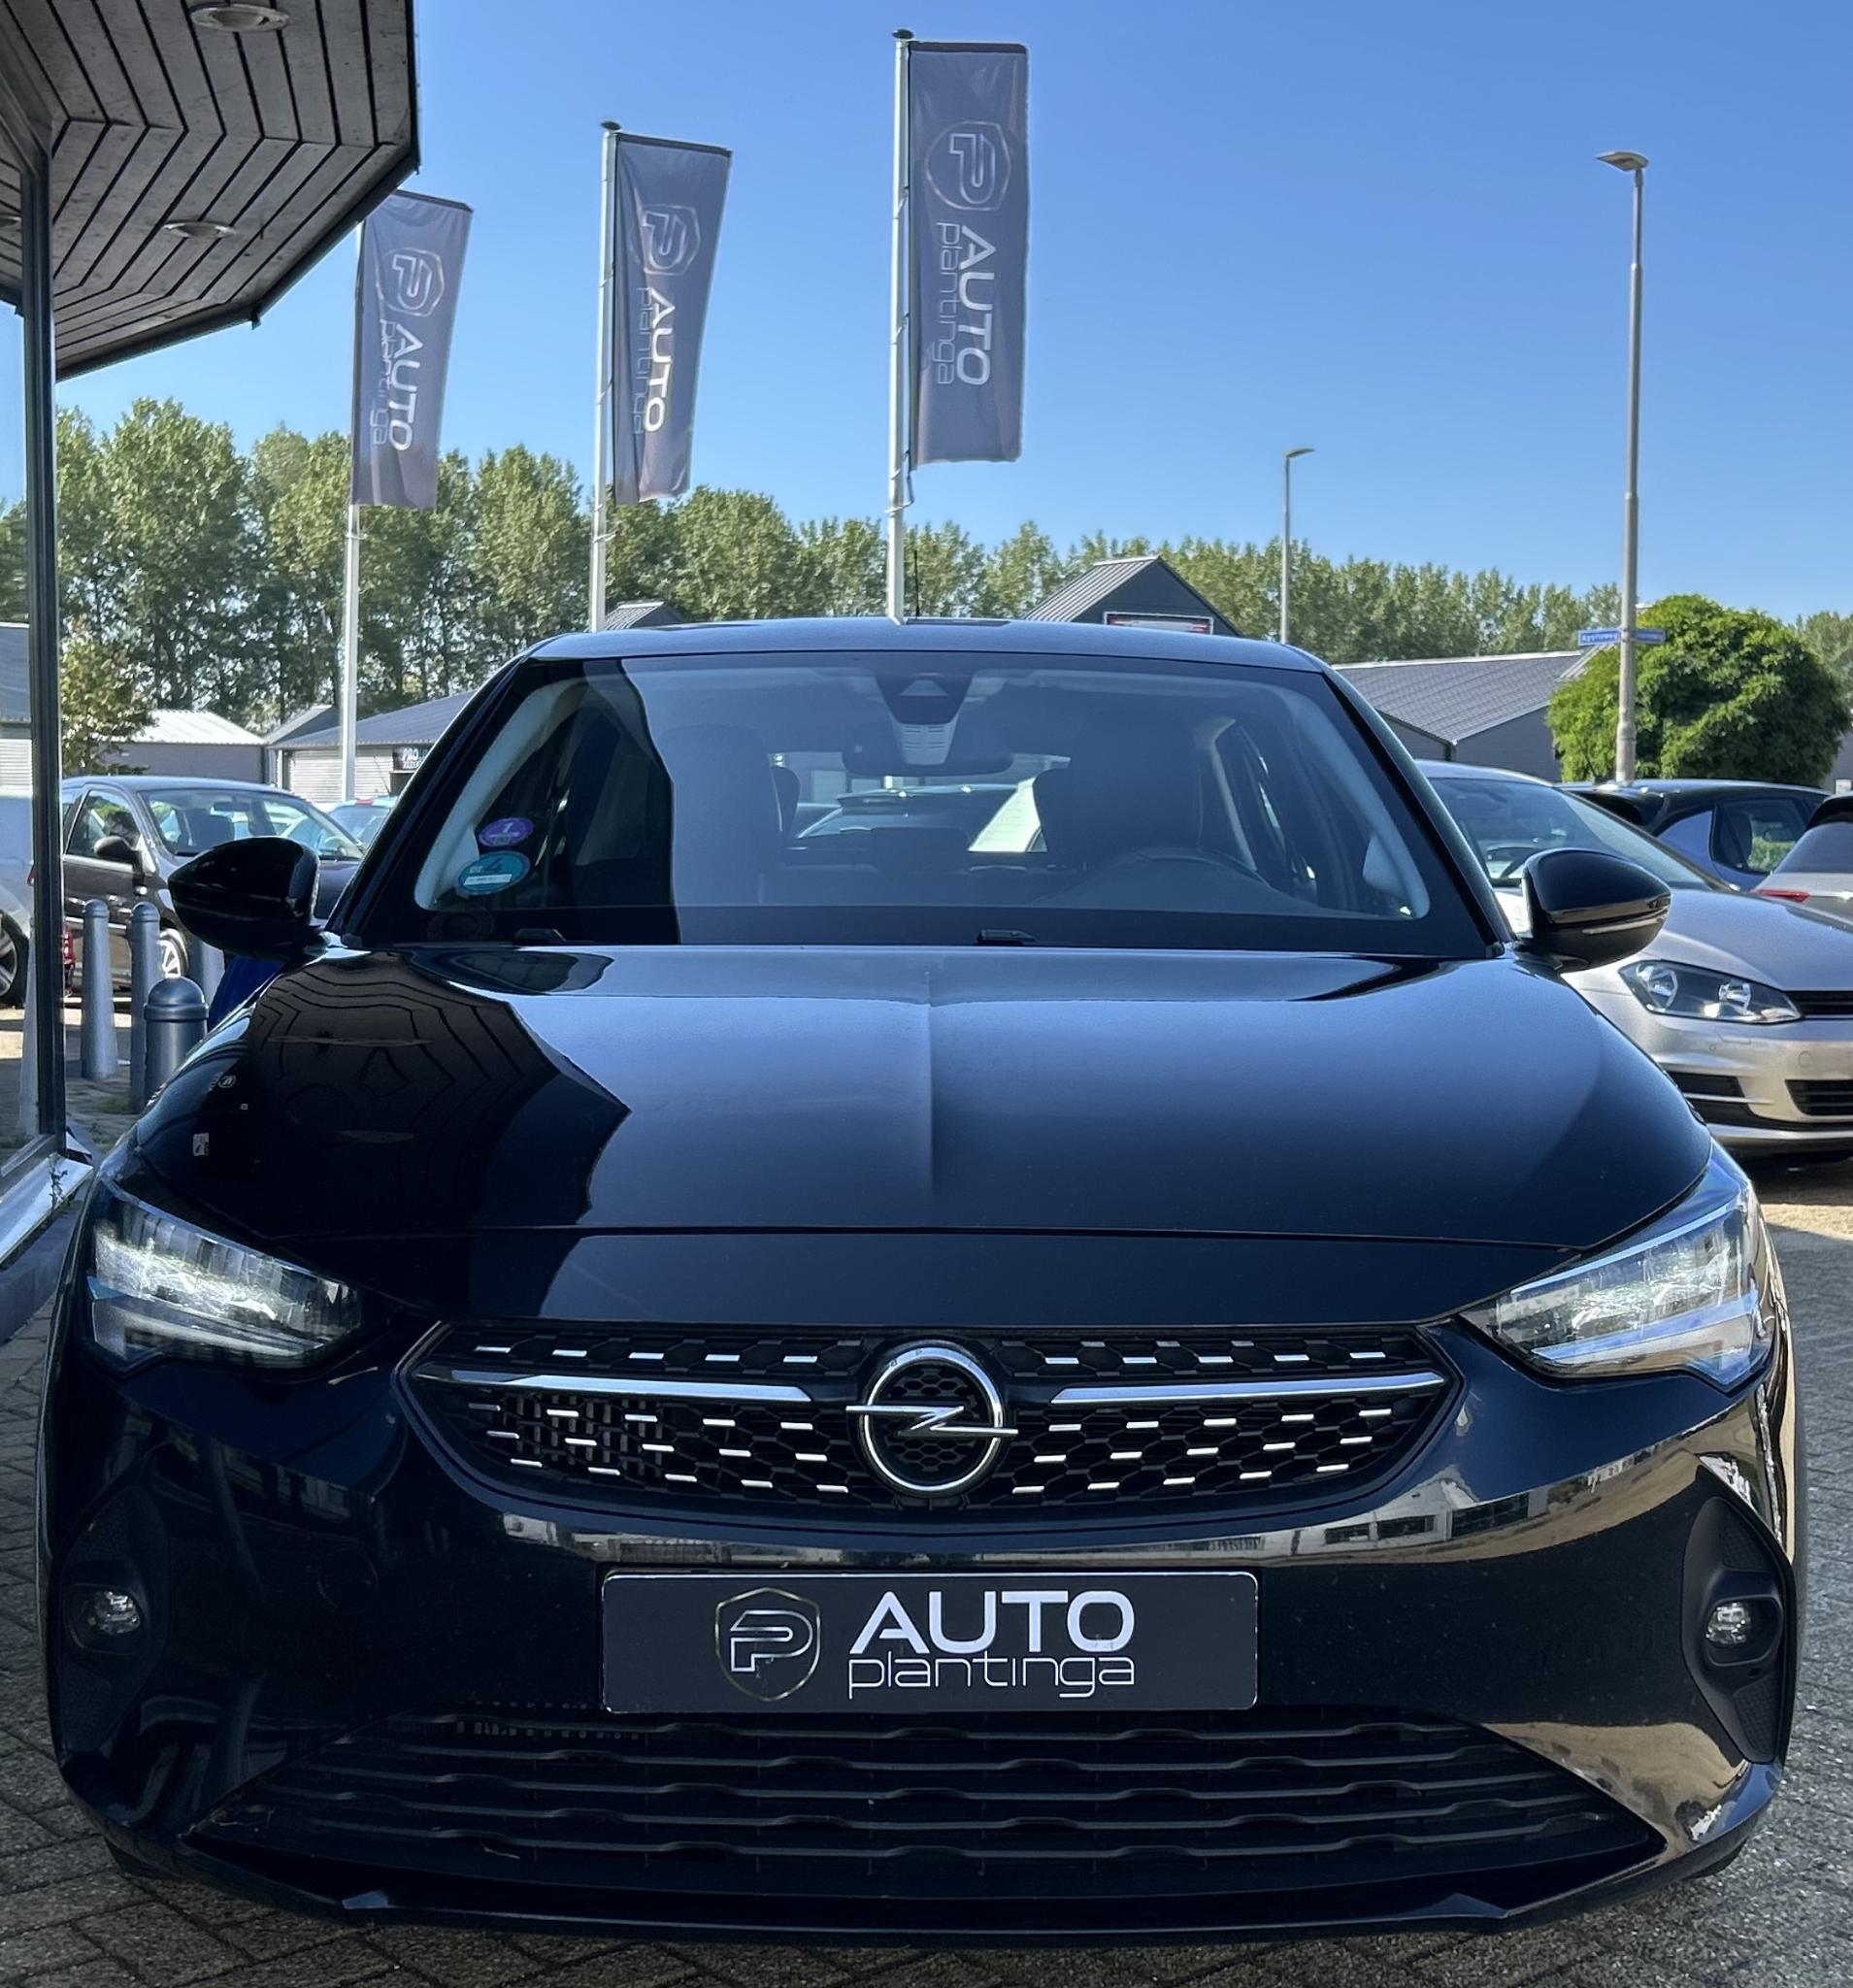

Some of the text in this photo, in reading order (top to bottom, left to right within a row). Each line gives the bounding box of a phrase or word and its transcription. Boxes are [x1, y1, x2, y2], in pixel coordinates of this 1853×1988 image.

[644, 287, 676, 432] AUTO
[932, 221, 962, 384] plantinga
[957, 224, 997, 385] AUTO
[389, 323, 423, 451] AUTO
[847, 1650, 1135, 1700] plantinga
[849, 1591, 1135, 1654] AUTO
